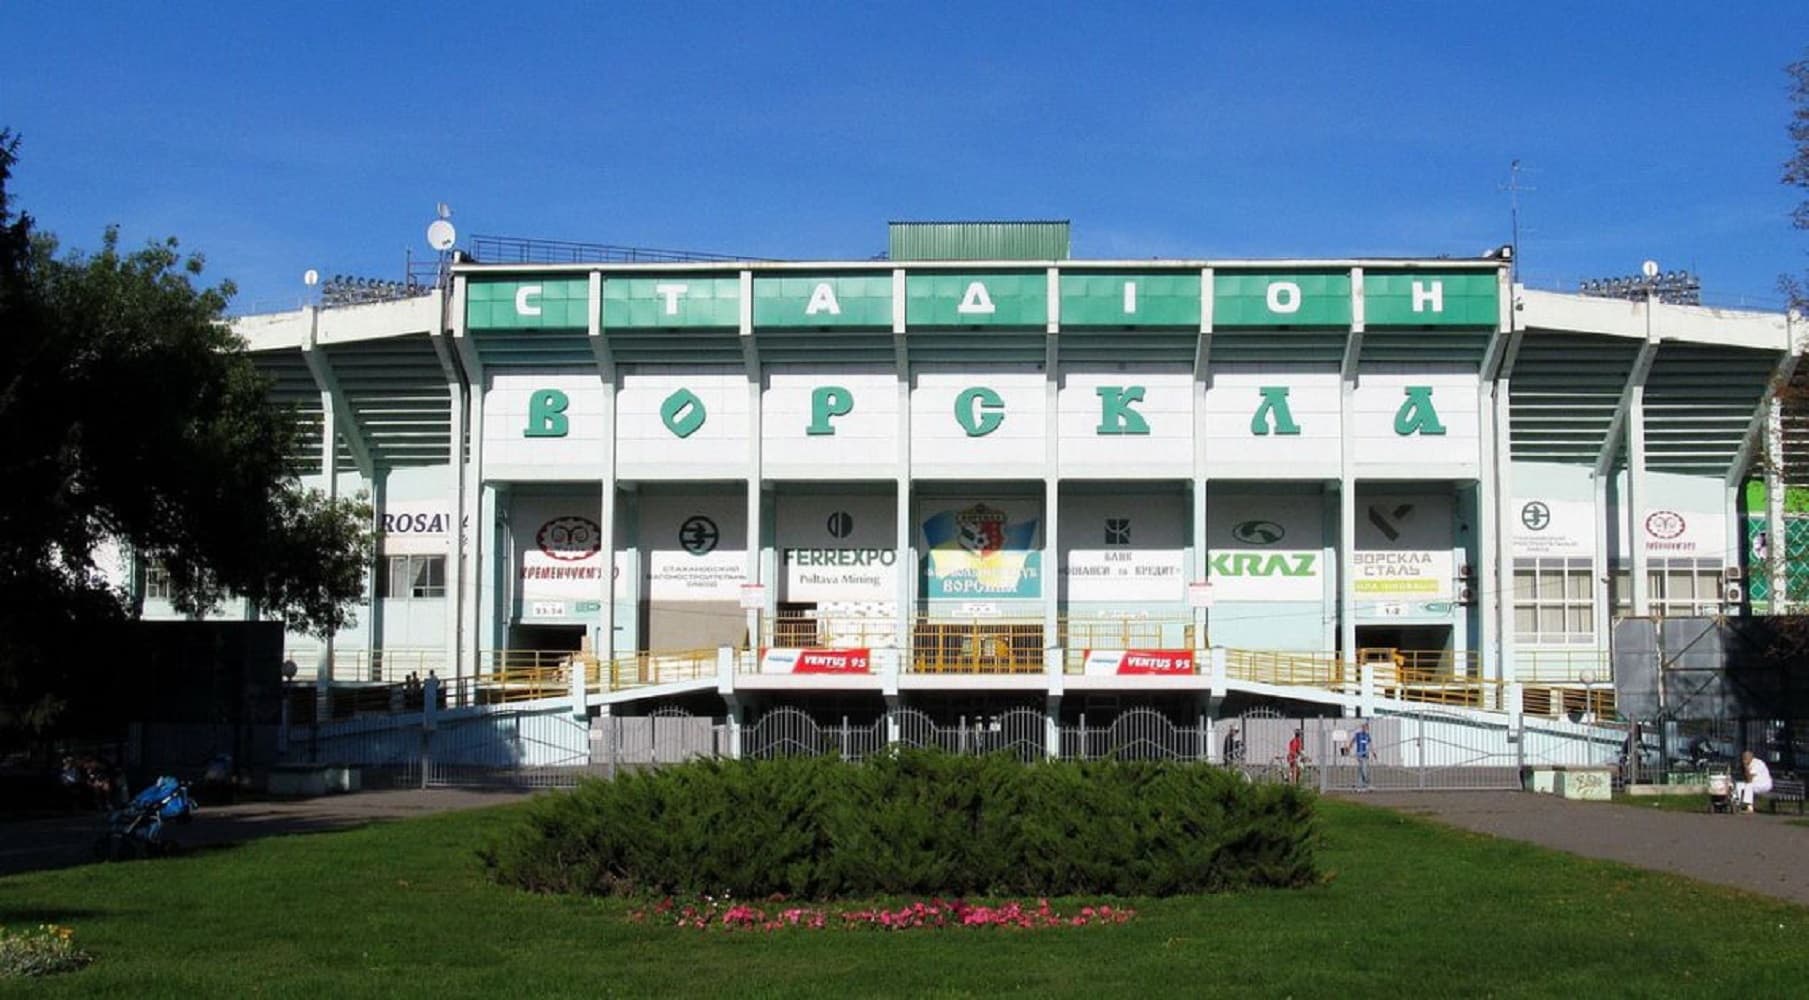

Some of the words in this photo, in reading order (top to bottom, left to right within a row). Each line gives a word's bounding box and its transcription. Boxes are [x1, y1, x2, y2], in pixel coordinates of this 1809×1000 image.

[515, 281, 1443, 316] СТАДІОН
[523, 386, 1446, 440] ВОРСКЛА
[784, 548, 896, 566] FERREXPO
[1353, 553, 1432, 565] ВОРСКЛА
[1208, 553, 1316, 577] KRAZ
[1364, 564, 1421, 576] СТАЛЬ
[800, 574, 838, 585] Poltava
[841, 574, 881, 586] Mining
[805, 655, 847, 668] VENTUS
[850, 657, 866, 668] 95
[1127, 656, 1171, 670] VENTUS
[1175, 658, 1191, 670] 95
